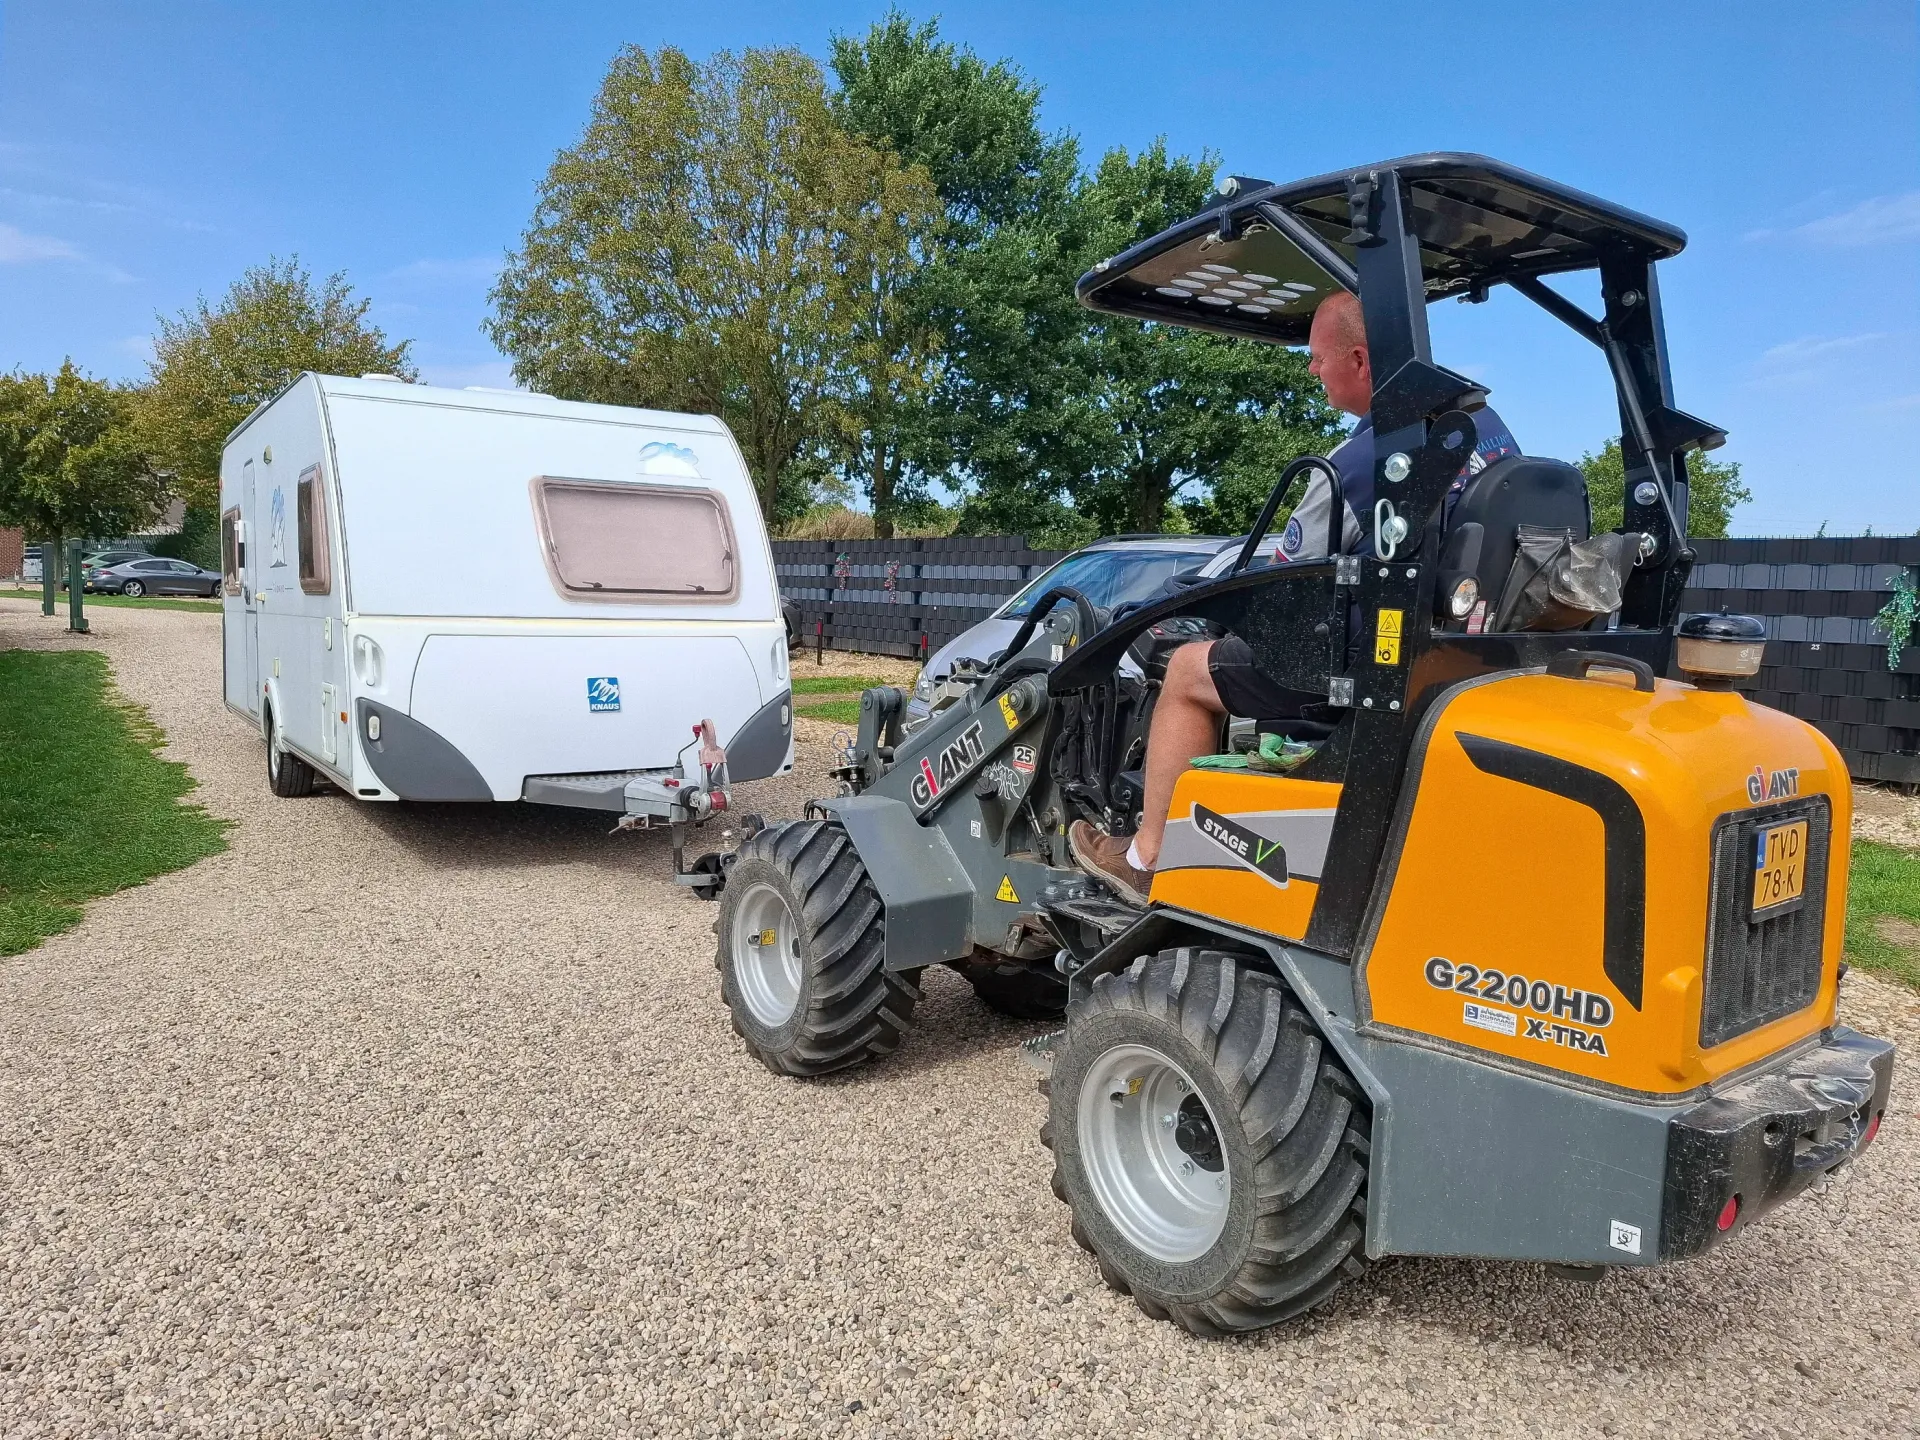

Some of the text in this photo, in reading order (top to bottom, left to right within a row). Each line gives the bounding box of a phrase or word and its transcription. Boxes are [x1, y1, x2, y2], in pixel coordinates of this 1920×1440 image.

[1016, 747, 1032, 763] 25
[1203, 818, 1281, 865] STAGE V
[1757, 854, 1764, 864] NL
[1770, 829, 1799, 863] TVD
[1761, 864, 1796, 902] 78-K
[1424, 957, 1614, 1027] G2200HD
[1522, 1015, 1609, 1058] X-TRA
